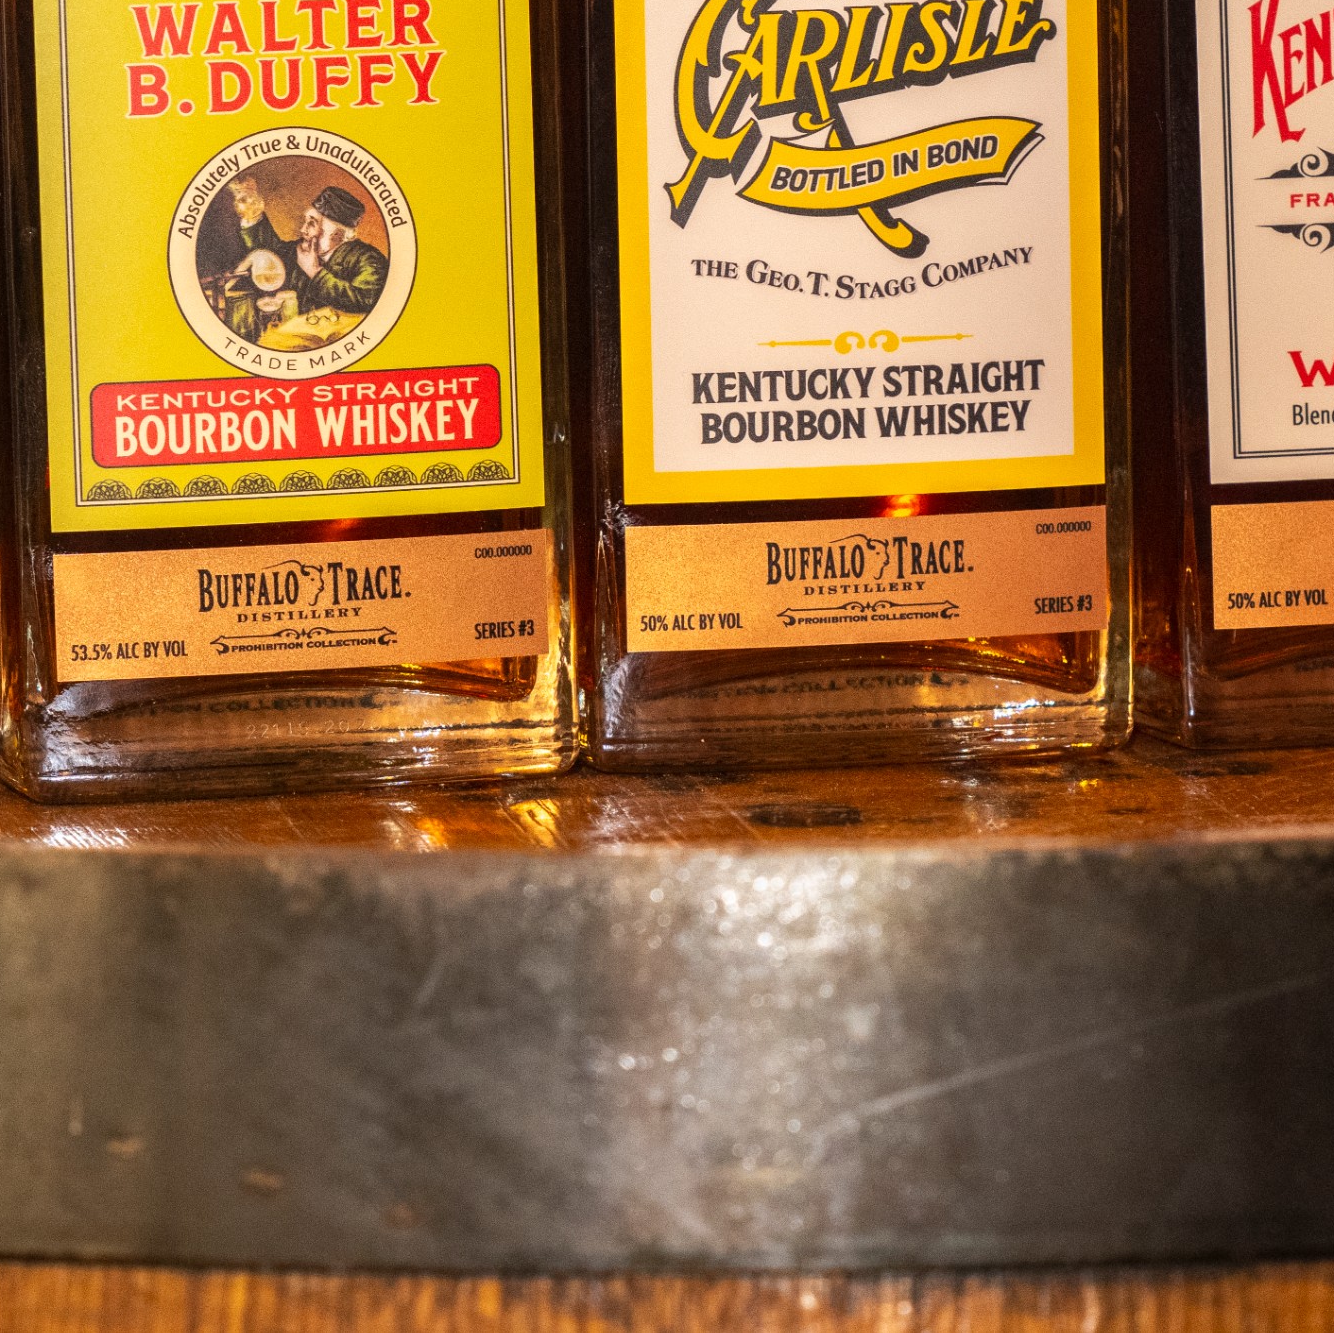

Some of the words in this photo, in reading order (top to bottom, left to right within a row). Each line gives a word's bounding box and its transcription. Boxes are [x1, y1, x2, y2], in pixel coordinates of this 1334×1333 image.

[124, 60, 194, 119] B.
[208, 49, 446, 114] DUFFY
[770, 154, 885, 193] BOTTLED
[893, 152, 918, 177] IN
[927, 135, 999, 168] BOND
[178, 152, 241, 240] Absolutely
[240, 137, 282, 161] True
[285, 135, 300, 150] &
[306, 135, 407, 229] Unadulterated
[691, 258, 739, 280] THE
[746, 259, 805, 294] GEO.
[807, 272, 830, 298] T.
[834, 274, 917, 300] STAGG
[921, 247, 1034, 289] COMPANY
[224, 336, 297, 371] TRADE
[309, 331, 371, 369] MARK
[116, 384, 298, 412] KENTUCKY
[312, 377, 480, 403] STRAIGHT
[692, 366, 877, 405] KENTUCKY
[882, 359, 1045, 397] STRAIGHT
[115, 407, 296, 458] BOURBON
[315, 399, 479, 447] WHISKEY
[700, 407, 867, 445] BOURBON
[876, 400, 1032, 438] WHISKEY
[766, 542, 865, 585] BUFFALO
[197, 569, 299, 613] BUFFALO
[804, 581, 926, 596] DISTILLERY
[1034, 596, 1074, 614] SERIES
[1077, 595, 1093, 611] #3
[1228, 592, 1256, 610] 50%
[1259, 591, 1281, 608] ALC
[1286, 590, 1301, 607] BY
[1304, 589, 1328, 606] VOL
[237, 607, 362, 623] DISTILLERY
[475, 621, 515, 640] SERIES
[518, 620, 534, 636] #3
[640, 615, 669, 632] 50%
[672, 614, 695, 630] ALC
[699, 614, 715, 630] BY
[718, 613, 743, 629] VOL
[797, 615, 867, 625] PROHIBITION
[871, 611, 939, 622] COLLECTION
[71, 643, 112, 662] 53.5%
[116, 642, 139, 659] ALC
[143, 641, 160, 658] BY
[162, 640, 188, 657] VOL
[231, 642, 303, 653] PROHIBITION
[307, 637, 376, 649] COLLECTION
